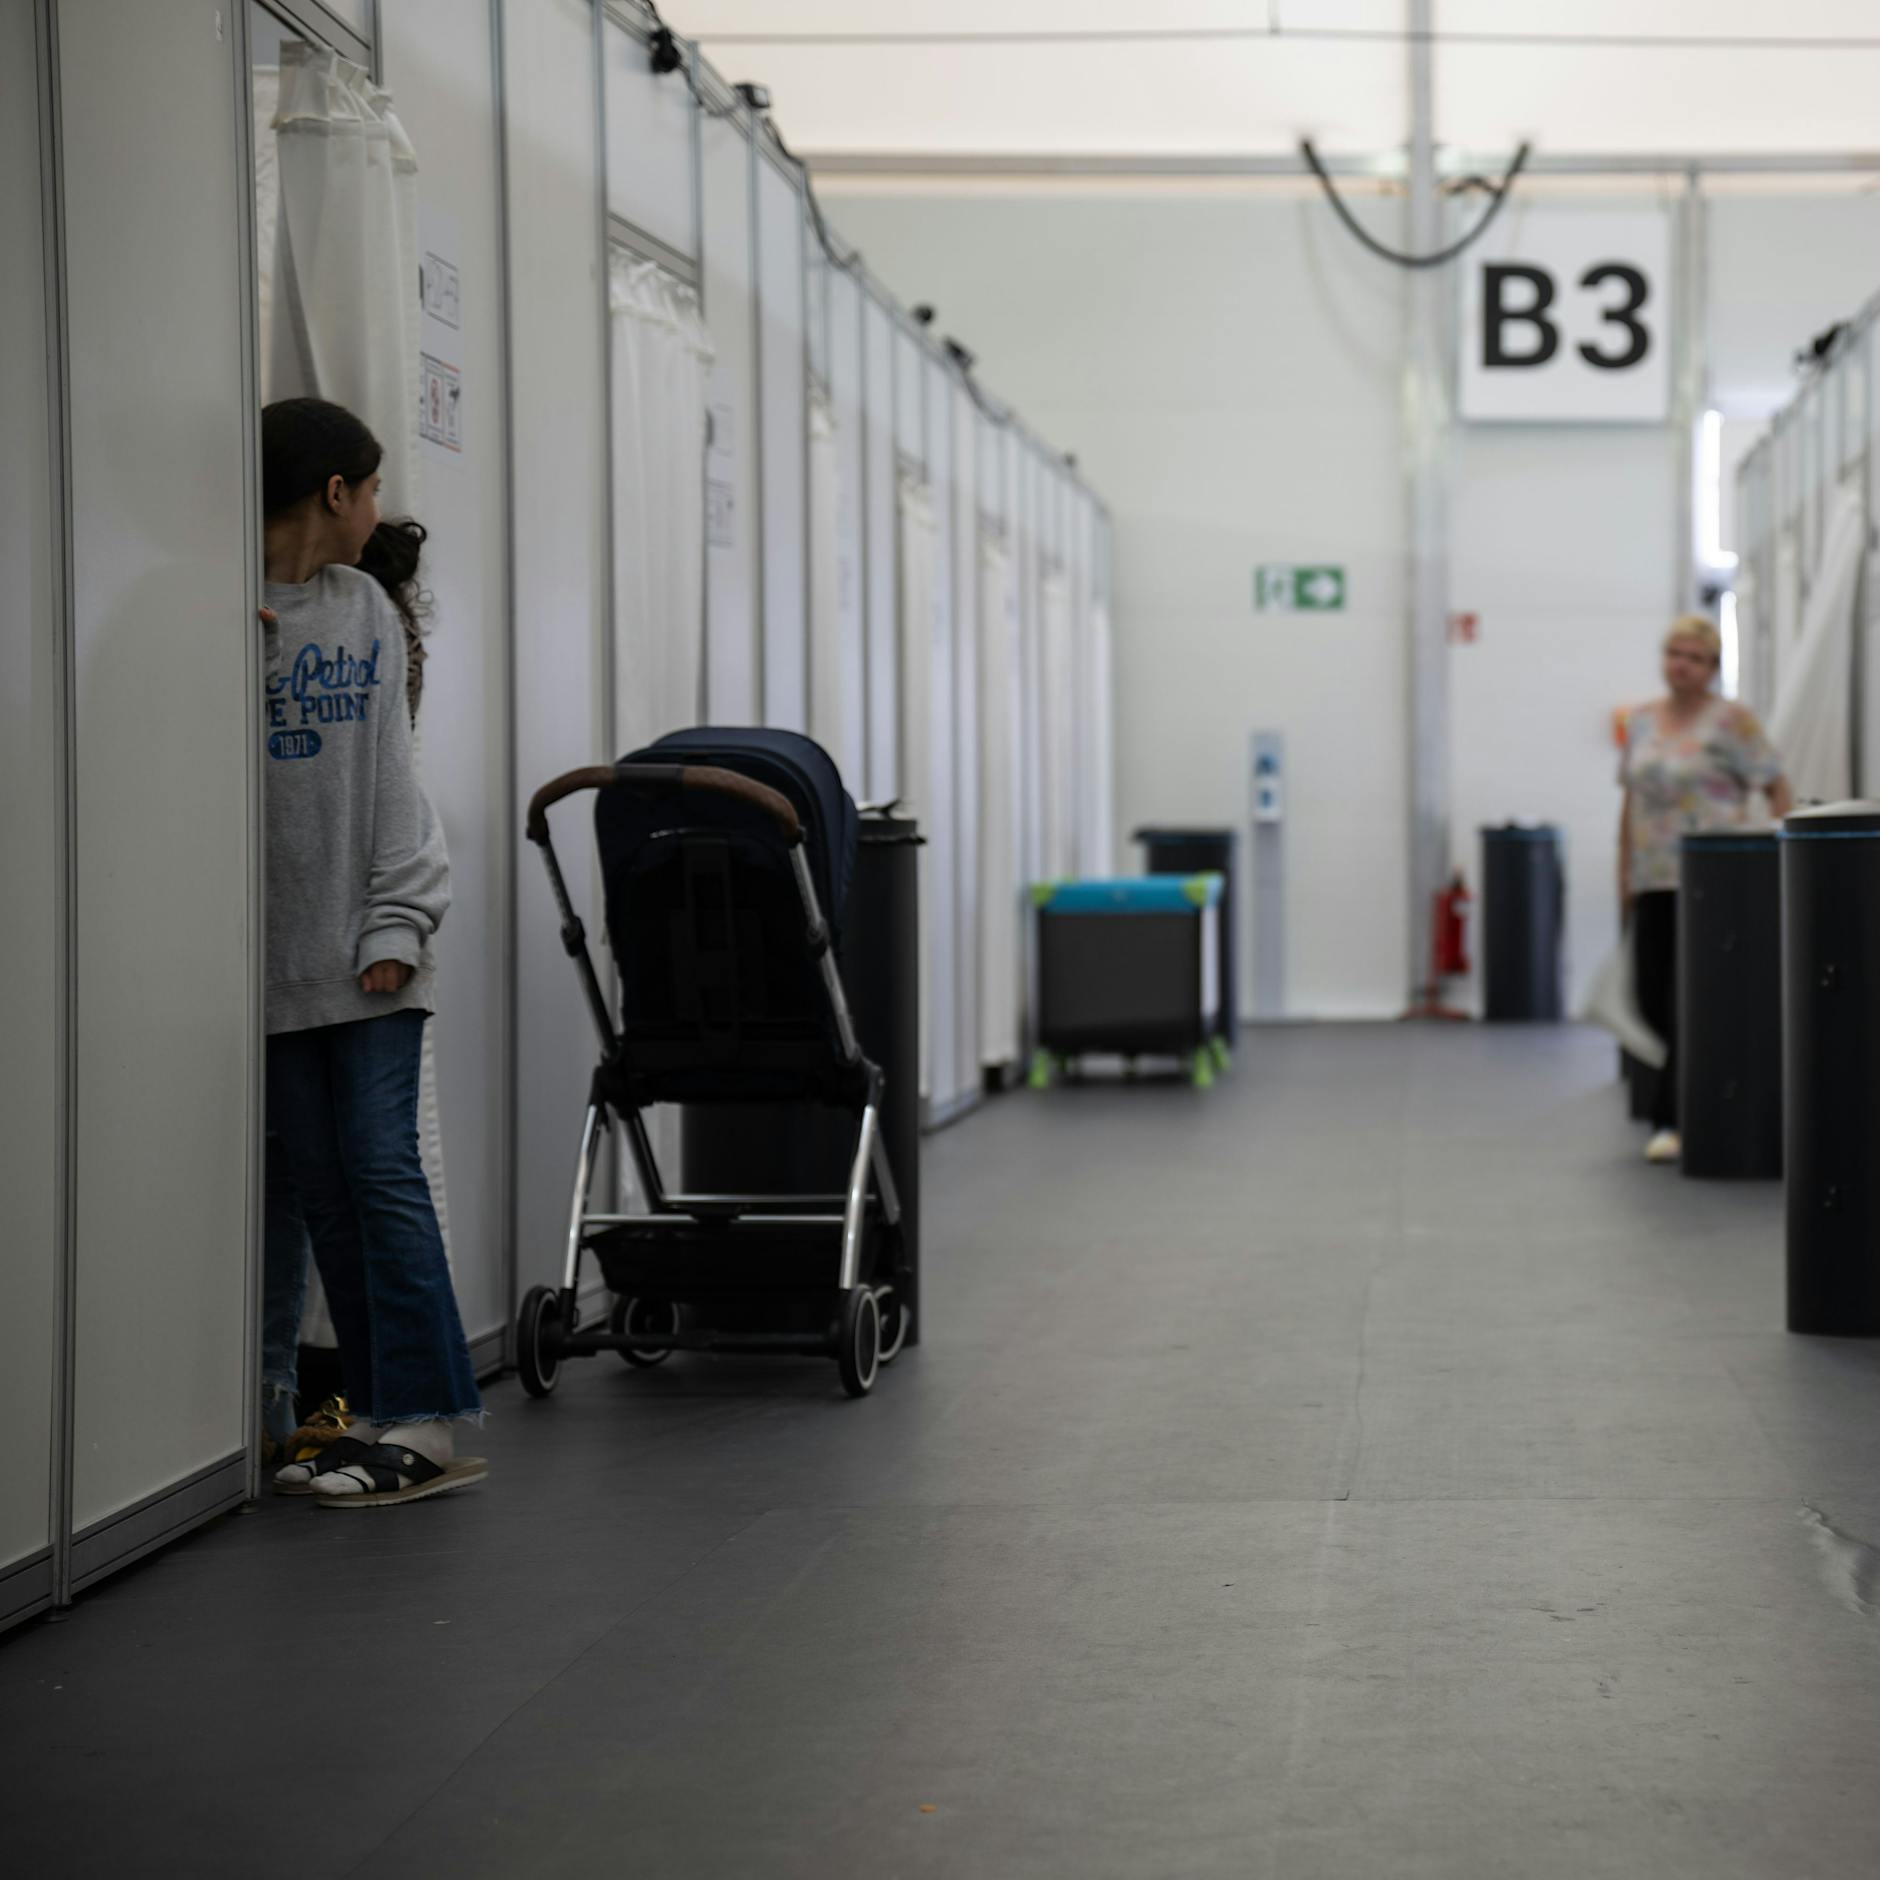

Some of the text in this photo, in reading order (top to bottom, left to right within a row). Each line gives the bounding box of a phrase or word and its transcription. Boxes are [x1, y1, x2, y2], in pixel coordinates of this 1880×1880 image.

[1482, 264, 1650, 369] B3
[300, 693, 369, 725] POINT
[279, 734, 308, 757] 1971
